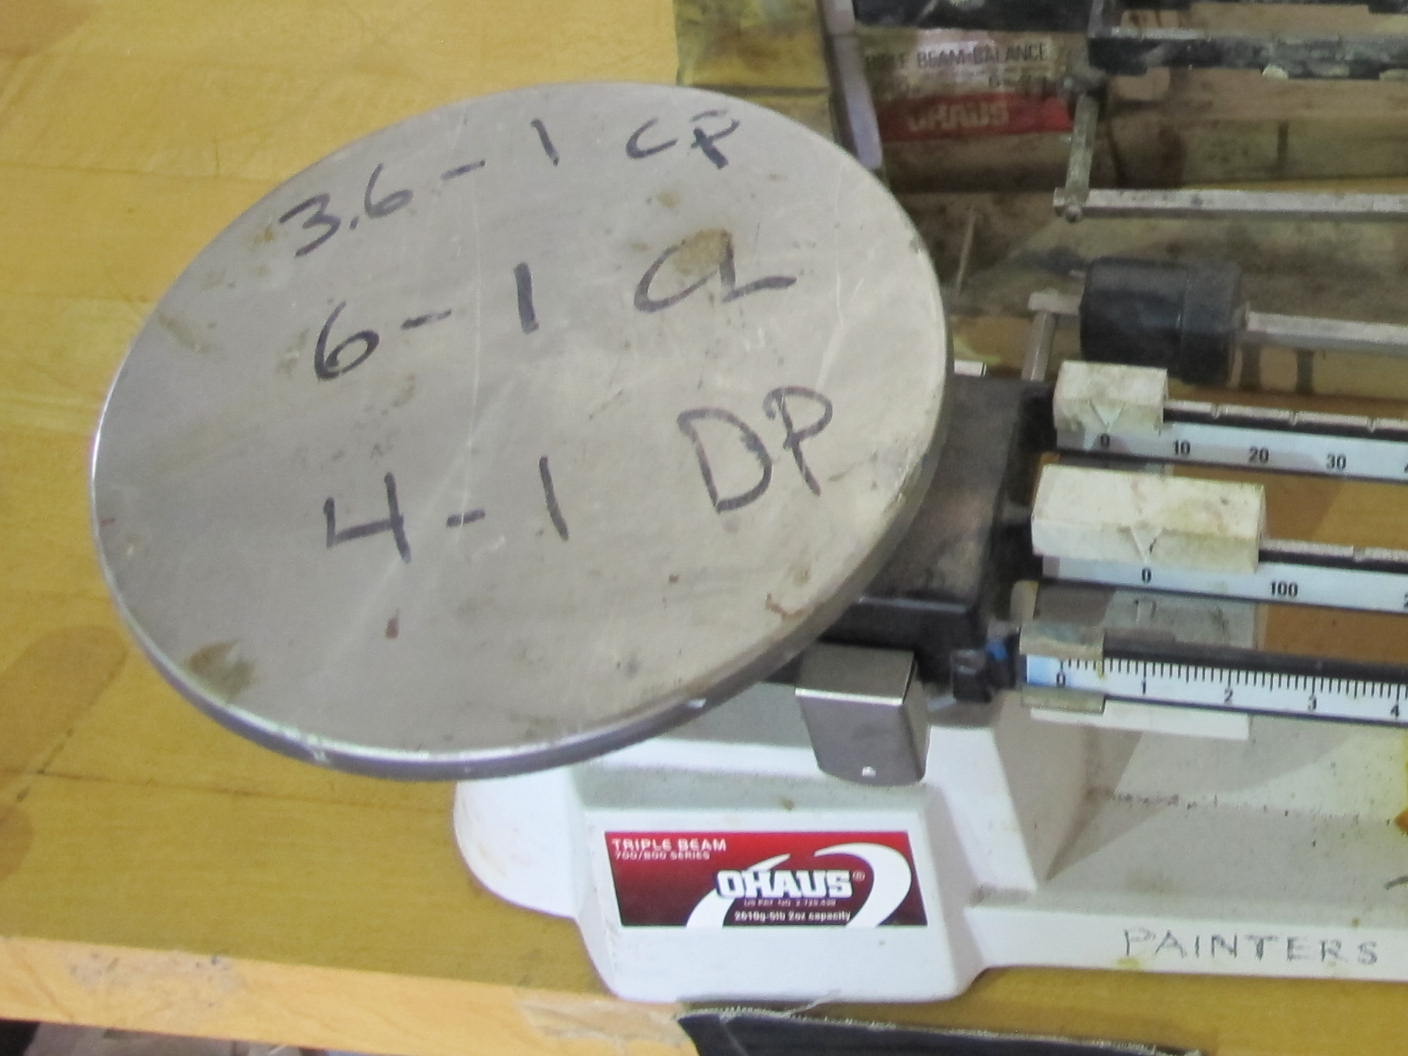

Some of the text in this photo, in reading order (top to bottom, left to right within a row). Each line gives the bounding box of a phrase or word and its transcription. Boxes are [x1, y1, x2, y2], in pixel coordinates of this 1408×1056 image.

[626, 110, 741, 169] CP
[677, 386, 833, 514] DP
[1173, 438, 1191, 455] 10
[1248, 446, 1269, 463] 20
[1326, 453, 1347, 471] 30
[1141, 567, 1151, 584] 0
[1271, 581, 1299, 598] 100
[1056, 671, 1067, 688] 0
[1224, 687, 1234, 705] 2
[1307, 694, 1317, 711] 3
[1391, 703, 1400, 718] 4
[612, 838, 727, 851] TRIPLE BEAM
[808, 910, 851, 923] capacity
[1123, 927, 1379, 966] PAINTERS
